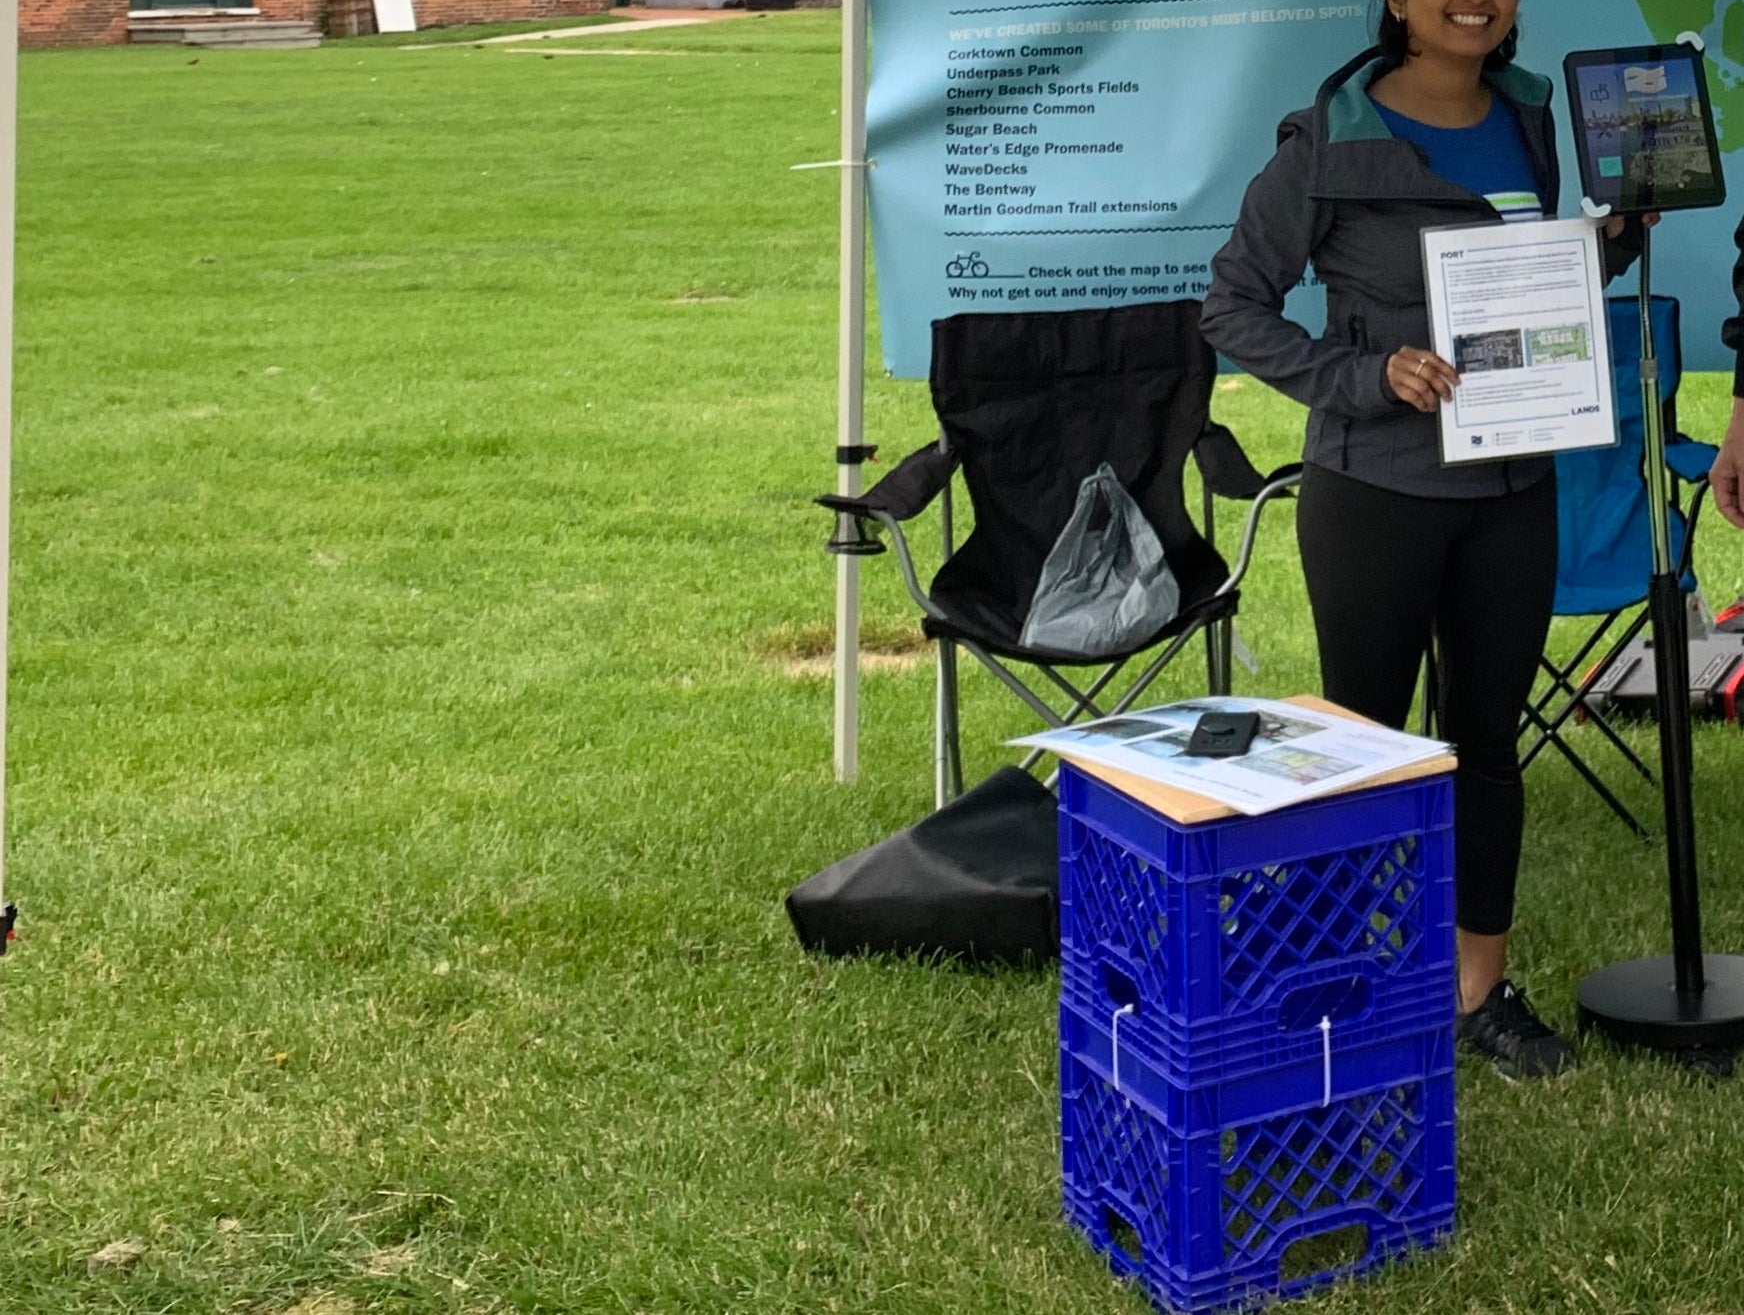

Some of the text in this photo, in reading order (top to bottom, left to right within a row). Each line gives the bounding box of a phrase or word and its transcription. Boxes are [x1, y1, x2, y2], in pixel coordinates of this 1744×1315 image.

[997, 23, 1062, 37] CREATED
[1066, 20, 1108, 34] SOME
[1112, 19, 1130, 31] OF
[1134, 15, 1210, 30] TORONTO'S
[1212, 12, 1248, 27] MOST
[1250, 8, 1315, 24] BELOVED
[948, 44, 1083, 61] Corktown Common
[946, 63, 1060, 81] Underpass Park
[946, 80, 1140, 101] Cherry Beach Sports Fields
[946, 101, 1096, 117] Sherbourne Common
[945, 122, 1038, 139] Sugar Beach
[945, 140, 1124, 157] Water's Edge Promenade
[945, 162, 1028, 176] WaveDecks
[945, 182, 1037, 199] The Bentway
[944, 199, 1178, 217] Martin Goodman Trail extensions
[1440, 250, 1464, 260] PORT
[1028, 263, 1208, 280] Check out the map to see
[948, 282, 1187, 302] Why not get out and enjoy some of
[1571, 404, 1600, 416] LANDS
